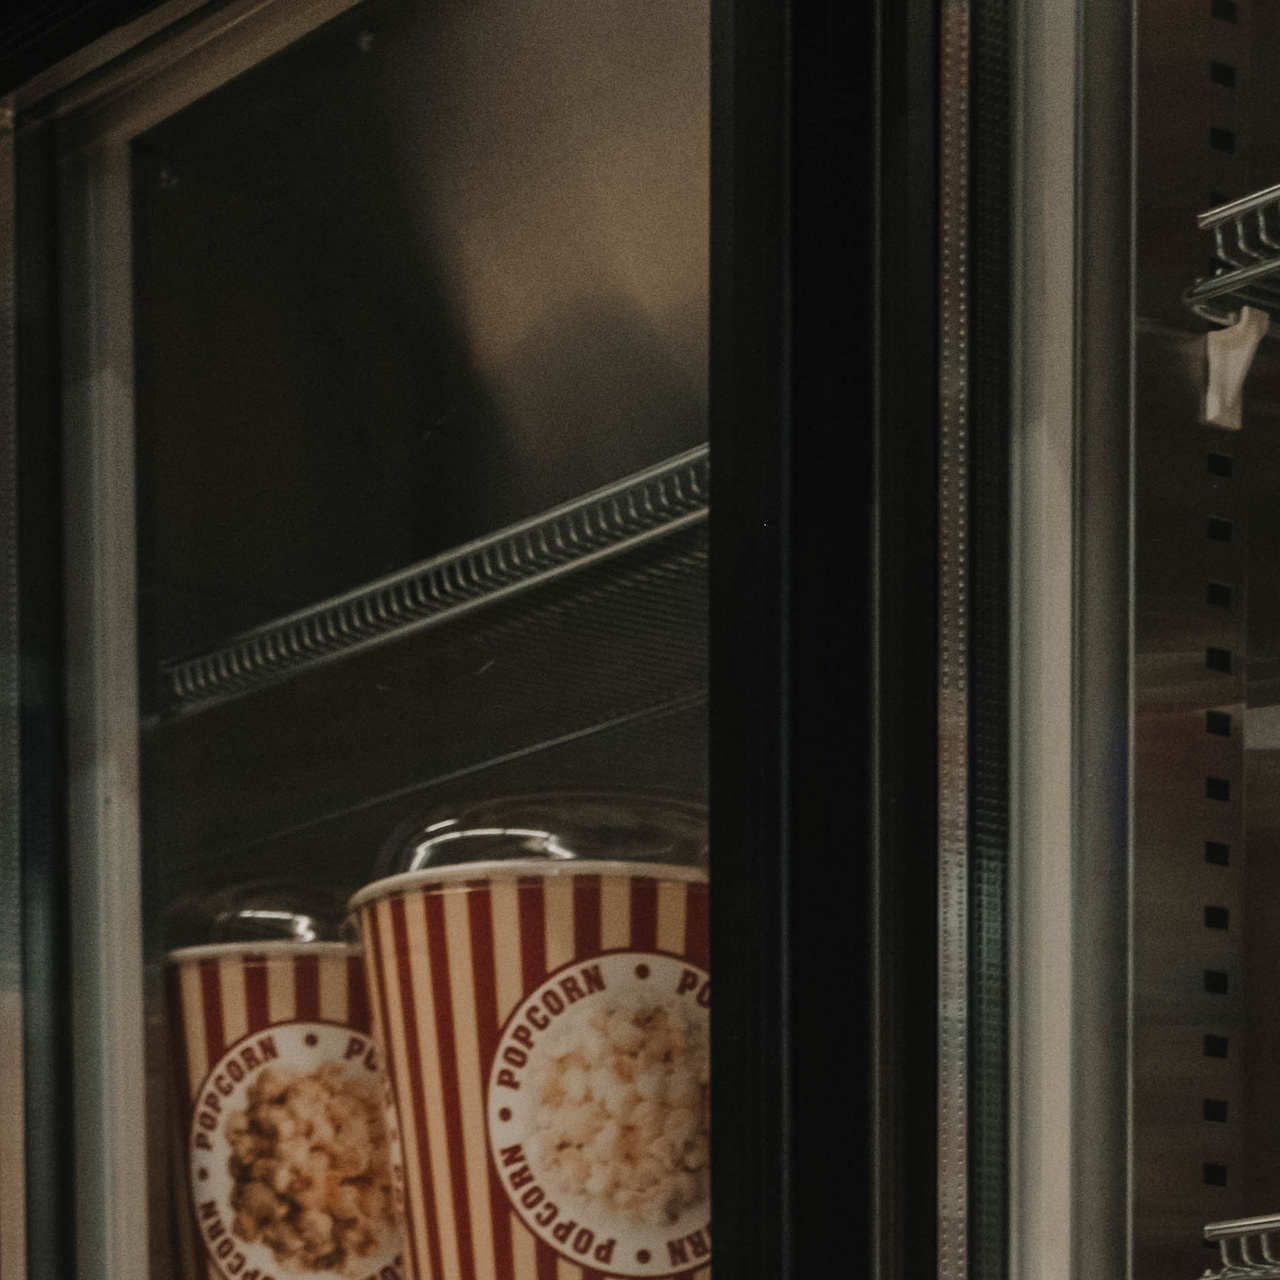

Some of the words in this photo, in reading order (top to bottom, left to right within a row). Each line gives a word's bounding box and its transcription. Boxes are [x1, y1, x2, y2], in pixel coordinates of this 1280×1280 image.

[496, 964, 606, 1091] POPCORN
[195, 1034, 280, 1151] POPCORN
[500, 1143, 617, 1266] POPCORN
